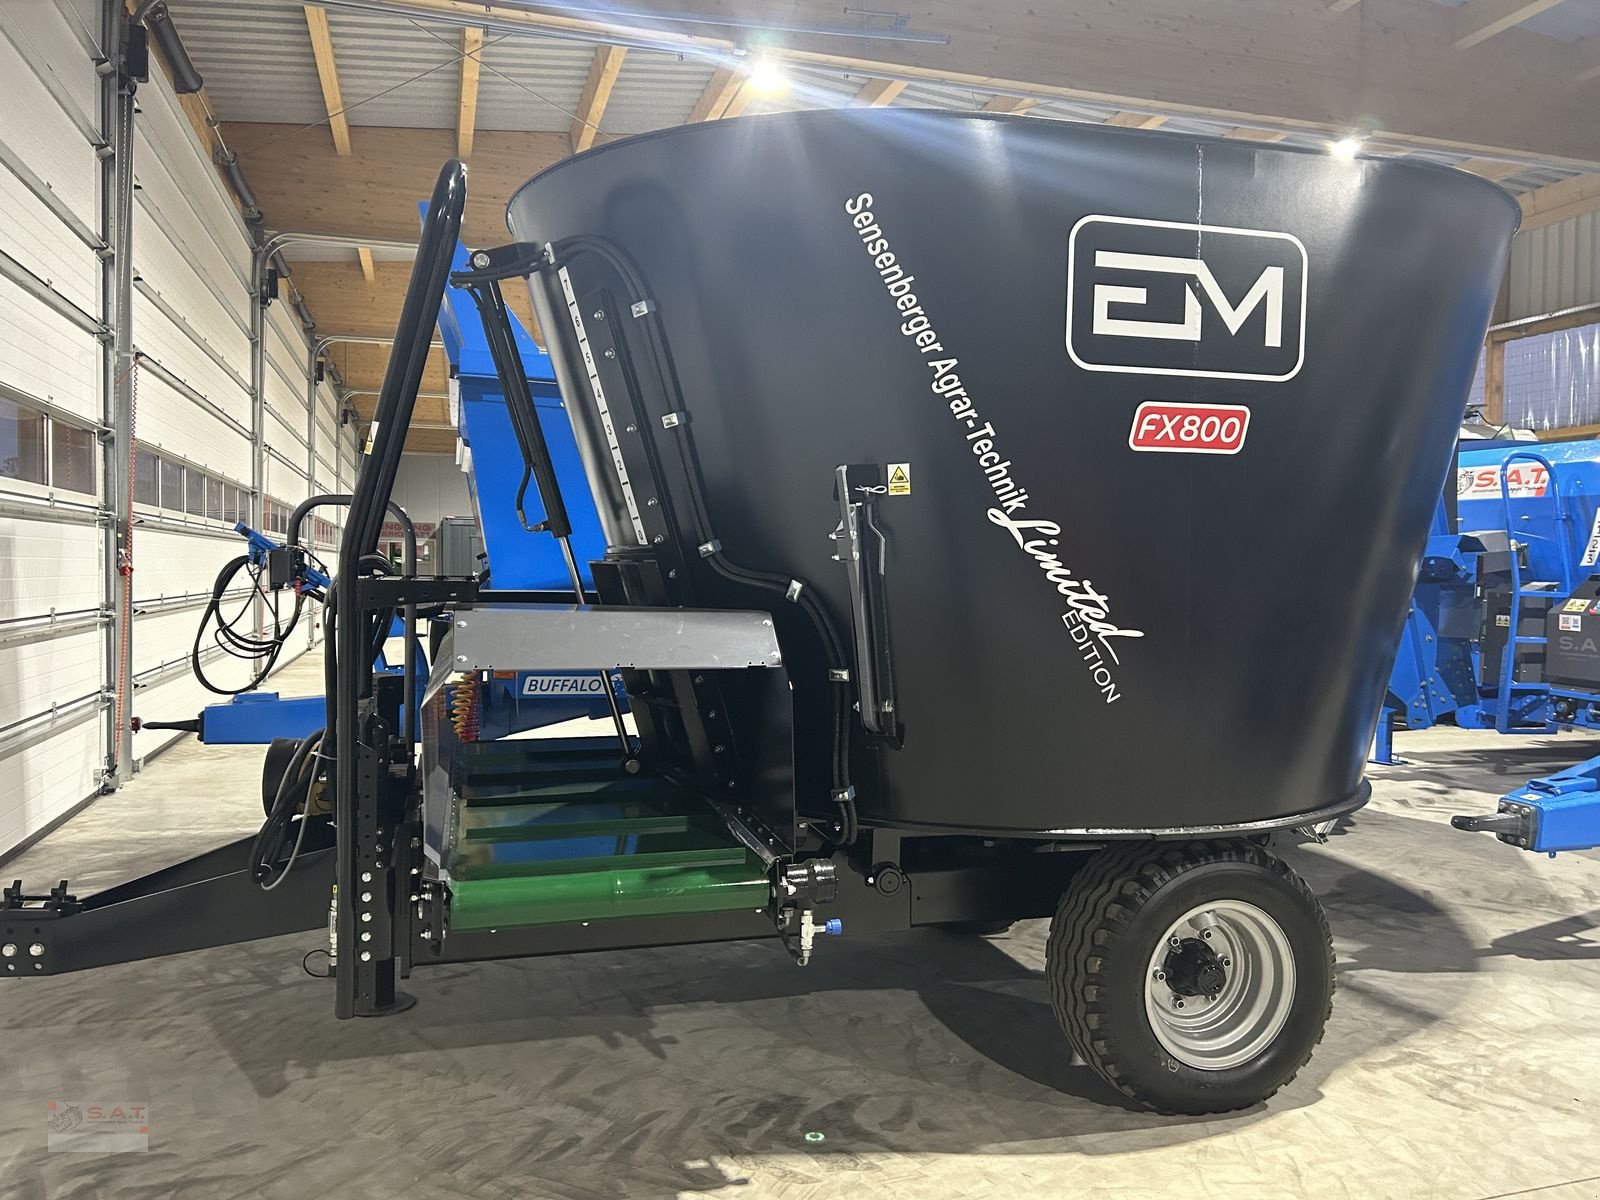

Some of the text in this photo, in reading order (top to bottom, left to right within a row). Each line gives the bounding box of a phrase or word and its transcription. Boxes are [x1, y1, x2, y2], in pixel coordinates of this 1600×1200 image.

[1092, 250, 1284, 348] EM
[845, 192, 1029, 515] Sensenberger Agrar-Technik
[1136, 413, 1242, 445] FX800
[1586, 554, 1594, 564] 3
[1591, 539, 1599, 549] 2
[987, 507, 1144, 666] Limited
[527, 679, 602, 692] BUFFALO
[1061, 608, 1121, 704] EDITION
